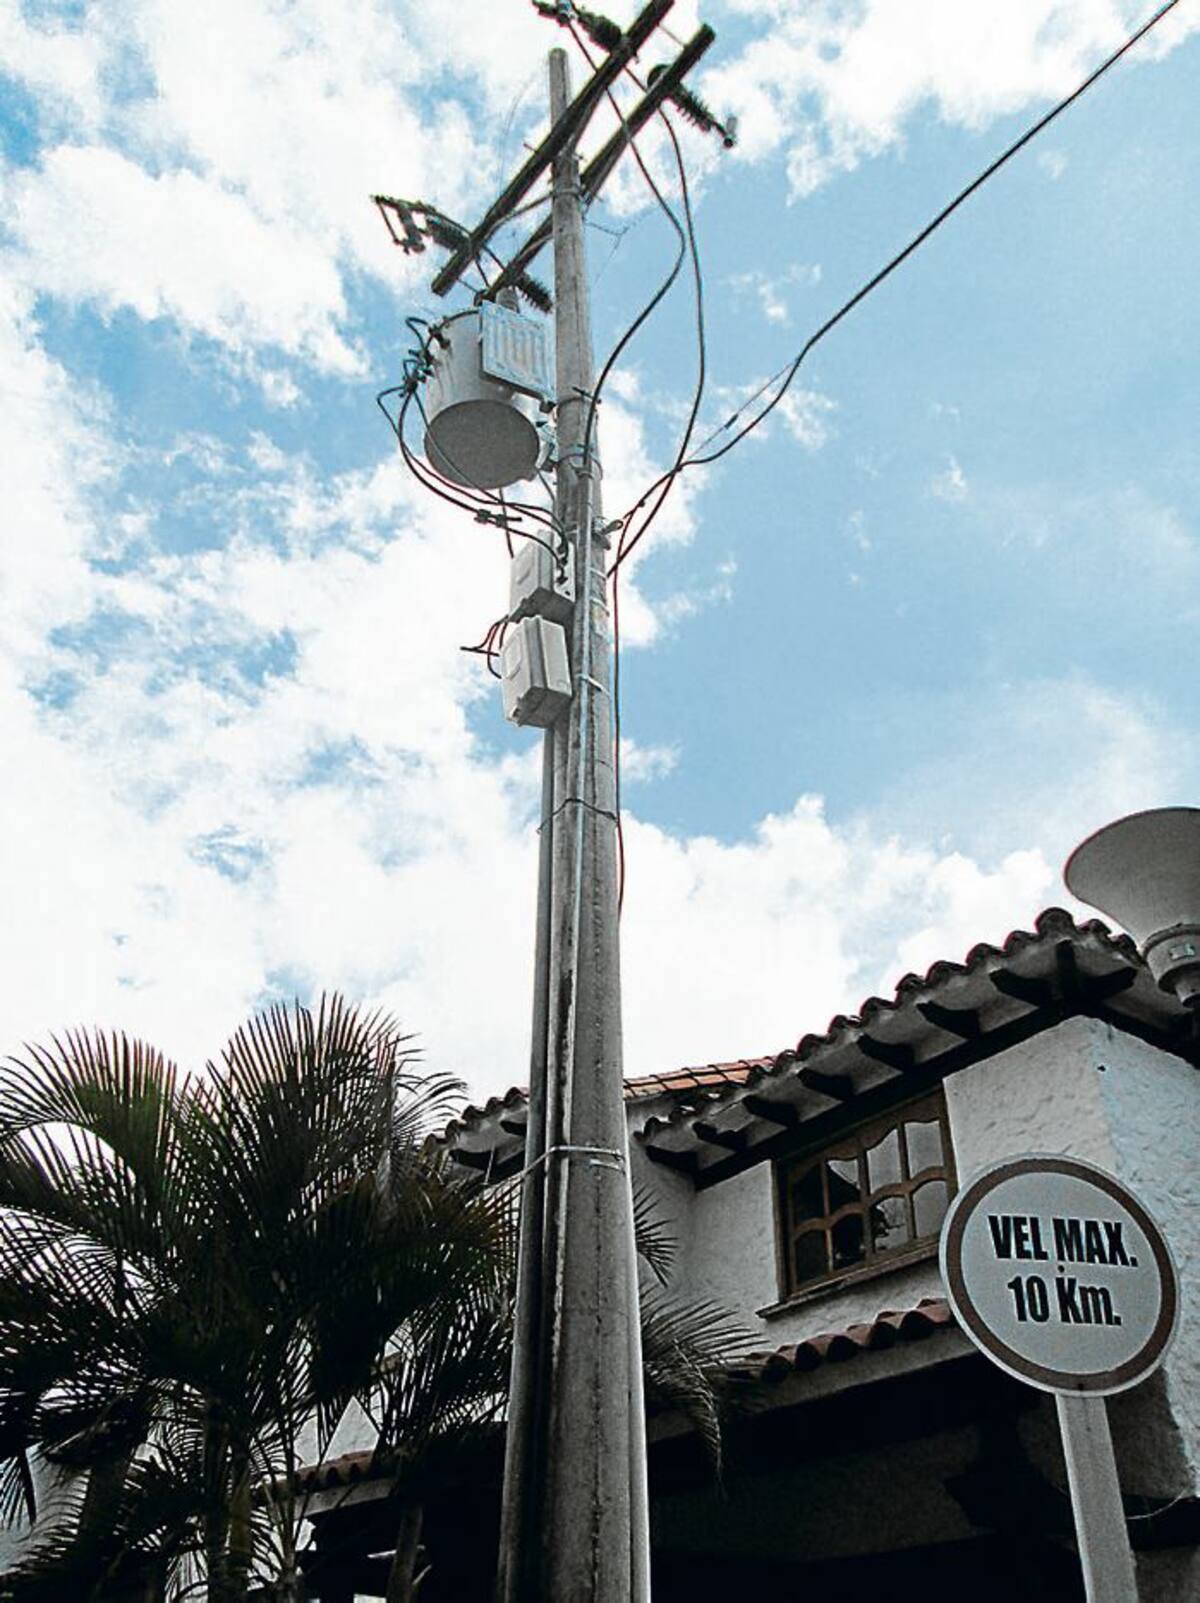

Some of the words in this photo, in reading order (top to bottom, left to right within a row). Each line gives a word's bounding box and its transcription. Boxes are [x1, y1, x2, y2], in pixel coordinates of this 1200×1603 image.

[988, 1215, 1048, 1260] VEL
[1053, 1218, 1138, 1267] MAX.
[1007, 1275, 1049, 1322] 10
[1056, 1276, 1122, 1325] Km.
